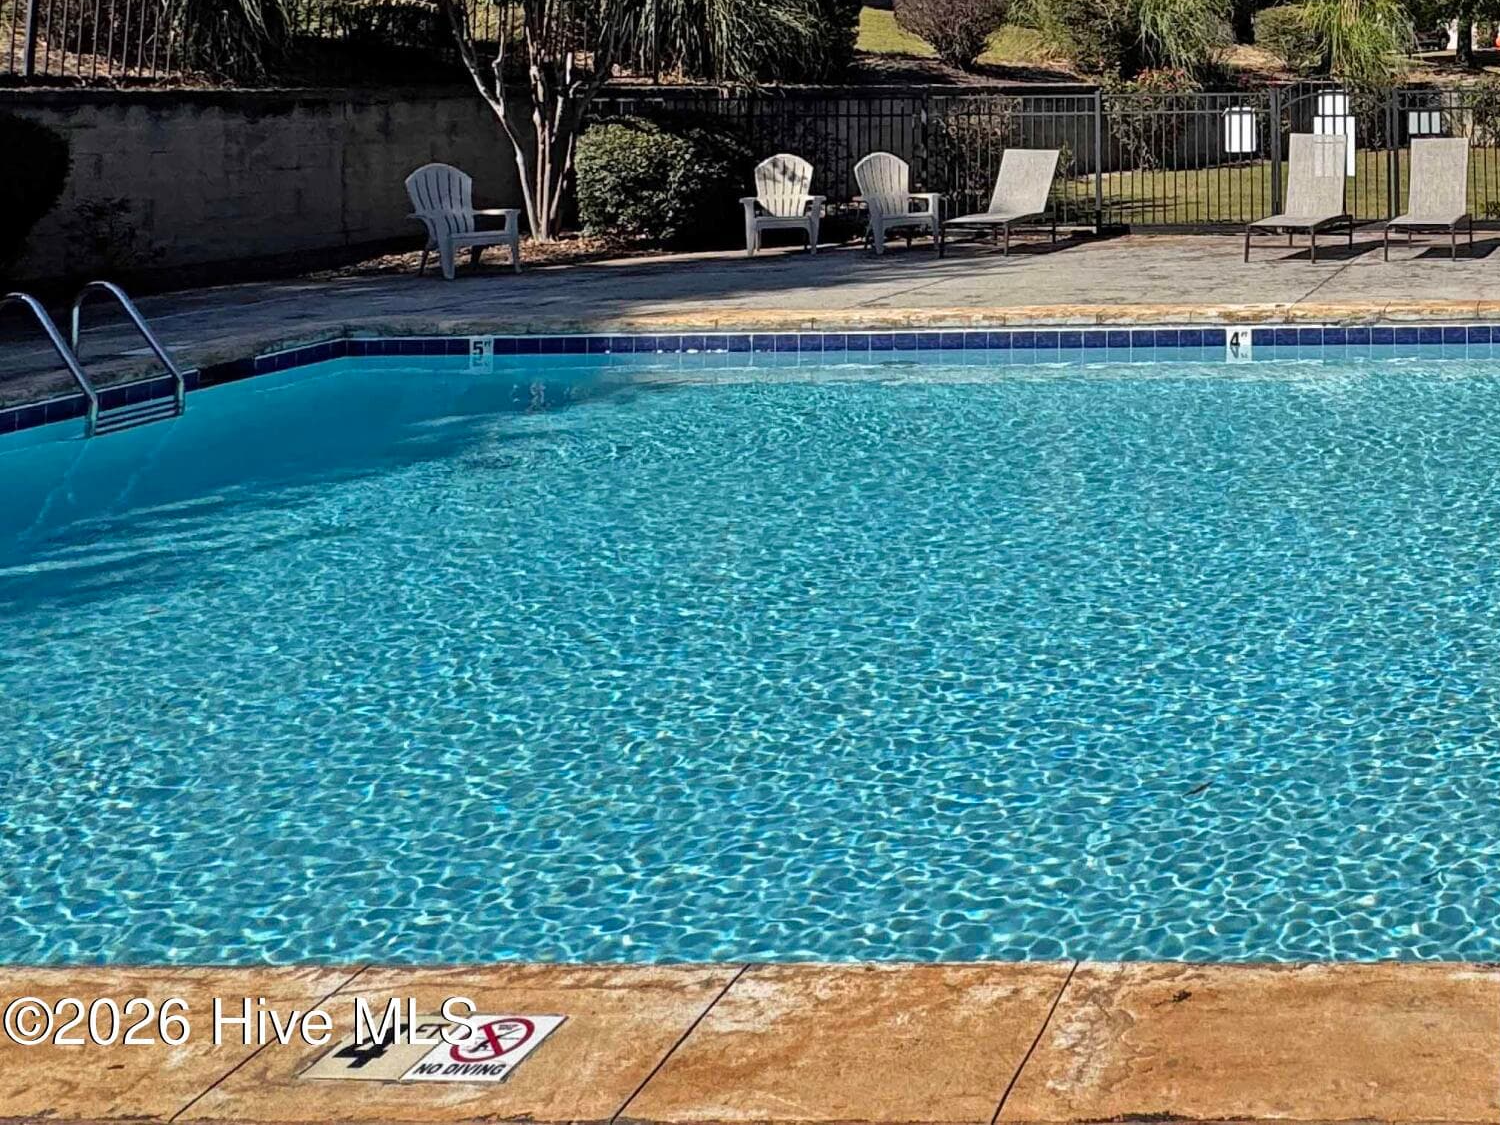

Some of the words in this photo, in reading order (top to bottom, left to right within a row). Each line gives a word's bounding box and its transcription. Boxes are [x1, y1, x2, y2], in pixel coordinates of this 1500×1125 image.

[1230, 332, 1240, 346] 4
[473, 341, 484, 355] 5
[332, 1024, 409, 1068] 4
[413, 1063, 444, 1075] NO
[441, 1063, 506, 1076] DIVING
